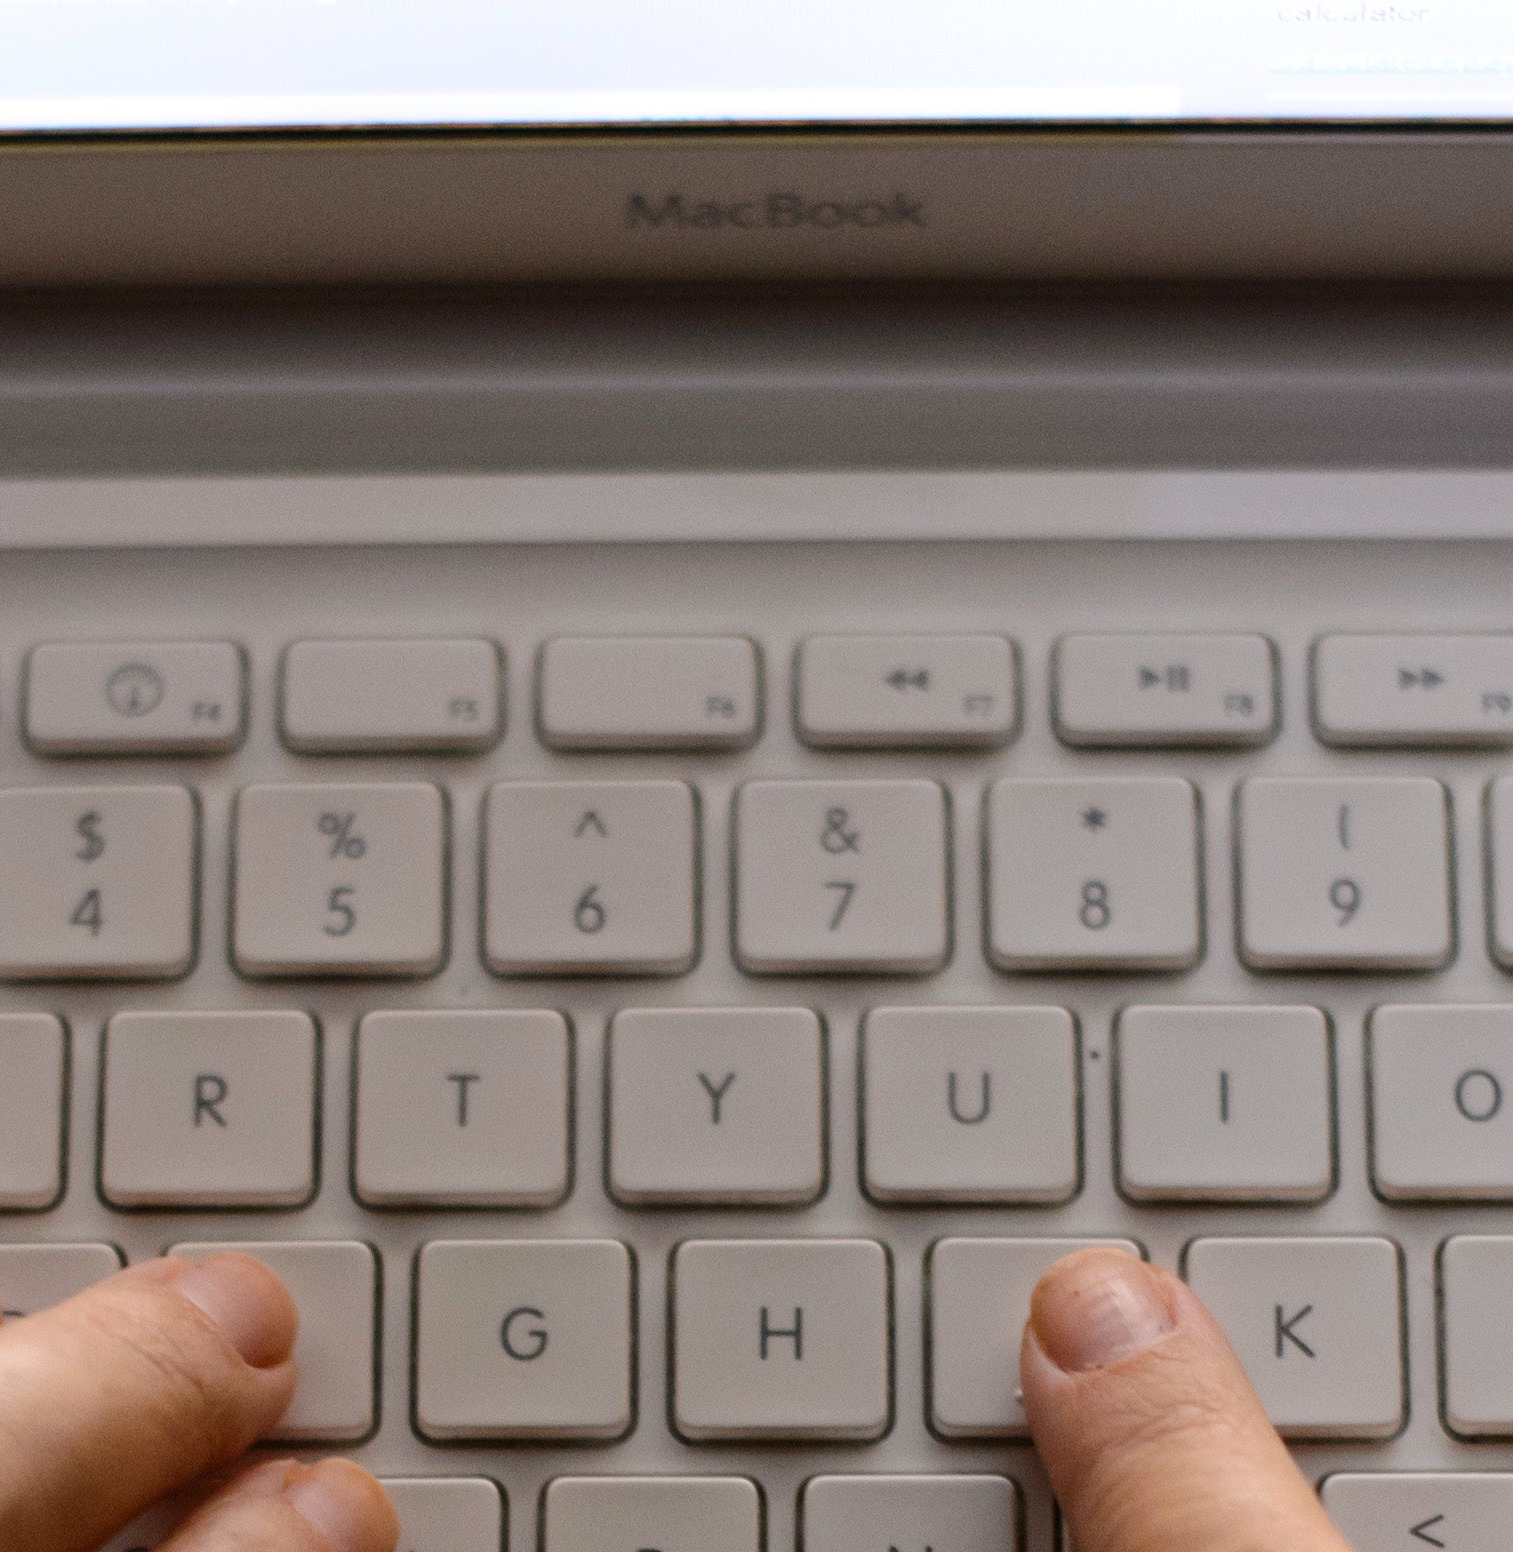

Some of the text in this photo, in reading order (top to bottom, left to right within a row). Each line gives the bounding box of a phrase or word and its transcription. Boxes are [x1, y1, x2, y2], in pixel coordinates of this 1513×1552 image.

[625, 192, 927, 229] MacBook
[191, 701, 222, 723] F4
[447, 697, 480, 722] F5
[705, 695, 737, 719] F6
[962, 692, 995, 716] F7
[1224, 693, 1255, 716] F8
[1481, 692, 1513, 714] F9
[75, 809, 106, 863] $
[316, 810, 368, 860] %
[574, 808, 608, 837] ^
[819, 805, 860, 855] &
[1336, 803, 1351, 851] (
[69, 887, 104, 936] 4
[323, 884, 357, 937] 5
[573, 884, 607, 934] 6
[824, 878, 858, 931] 7
[1078, 879, 1112, 931] 8
[1327, 876, 1363, 926] 9
[193, 1074, 228, 1127] R
[446, 1072, 481, 1128] T
[697, 1072, 736, 1125] Y
[946, 1071, 993, 1126] U
[1218, 1070, 1231, 1123] I
[1452, 1067, 1504, 1124] O
[498, 1305, 549, 1363] G
[758, 1306, 804, 1361] H
[1273, 1304, 1316, 1359] K
[1408, 1513, 1446, 1549] <
